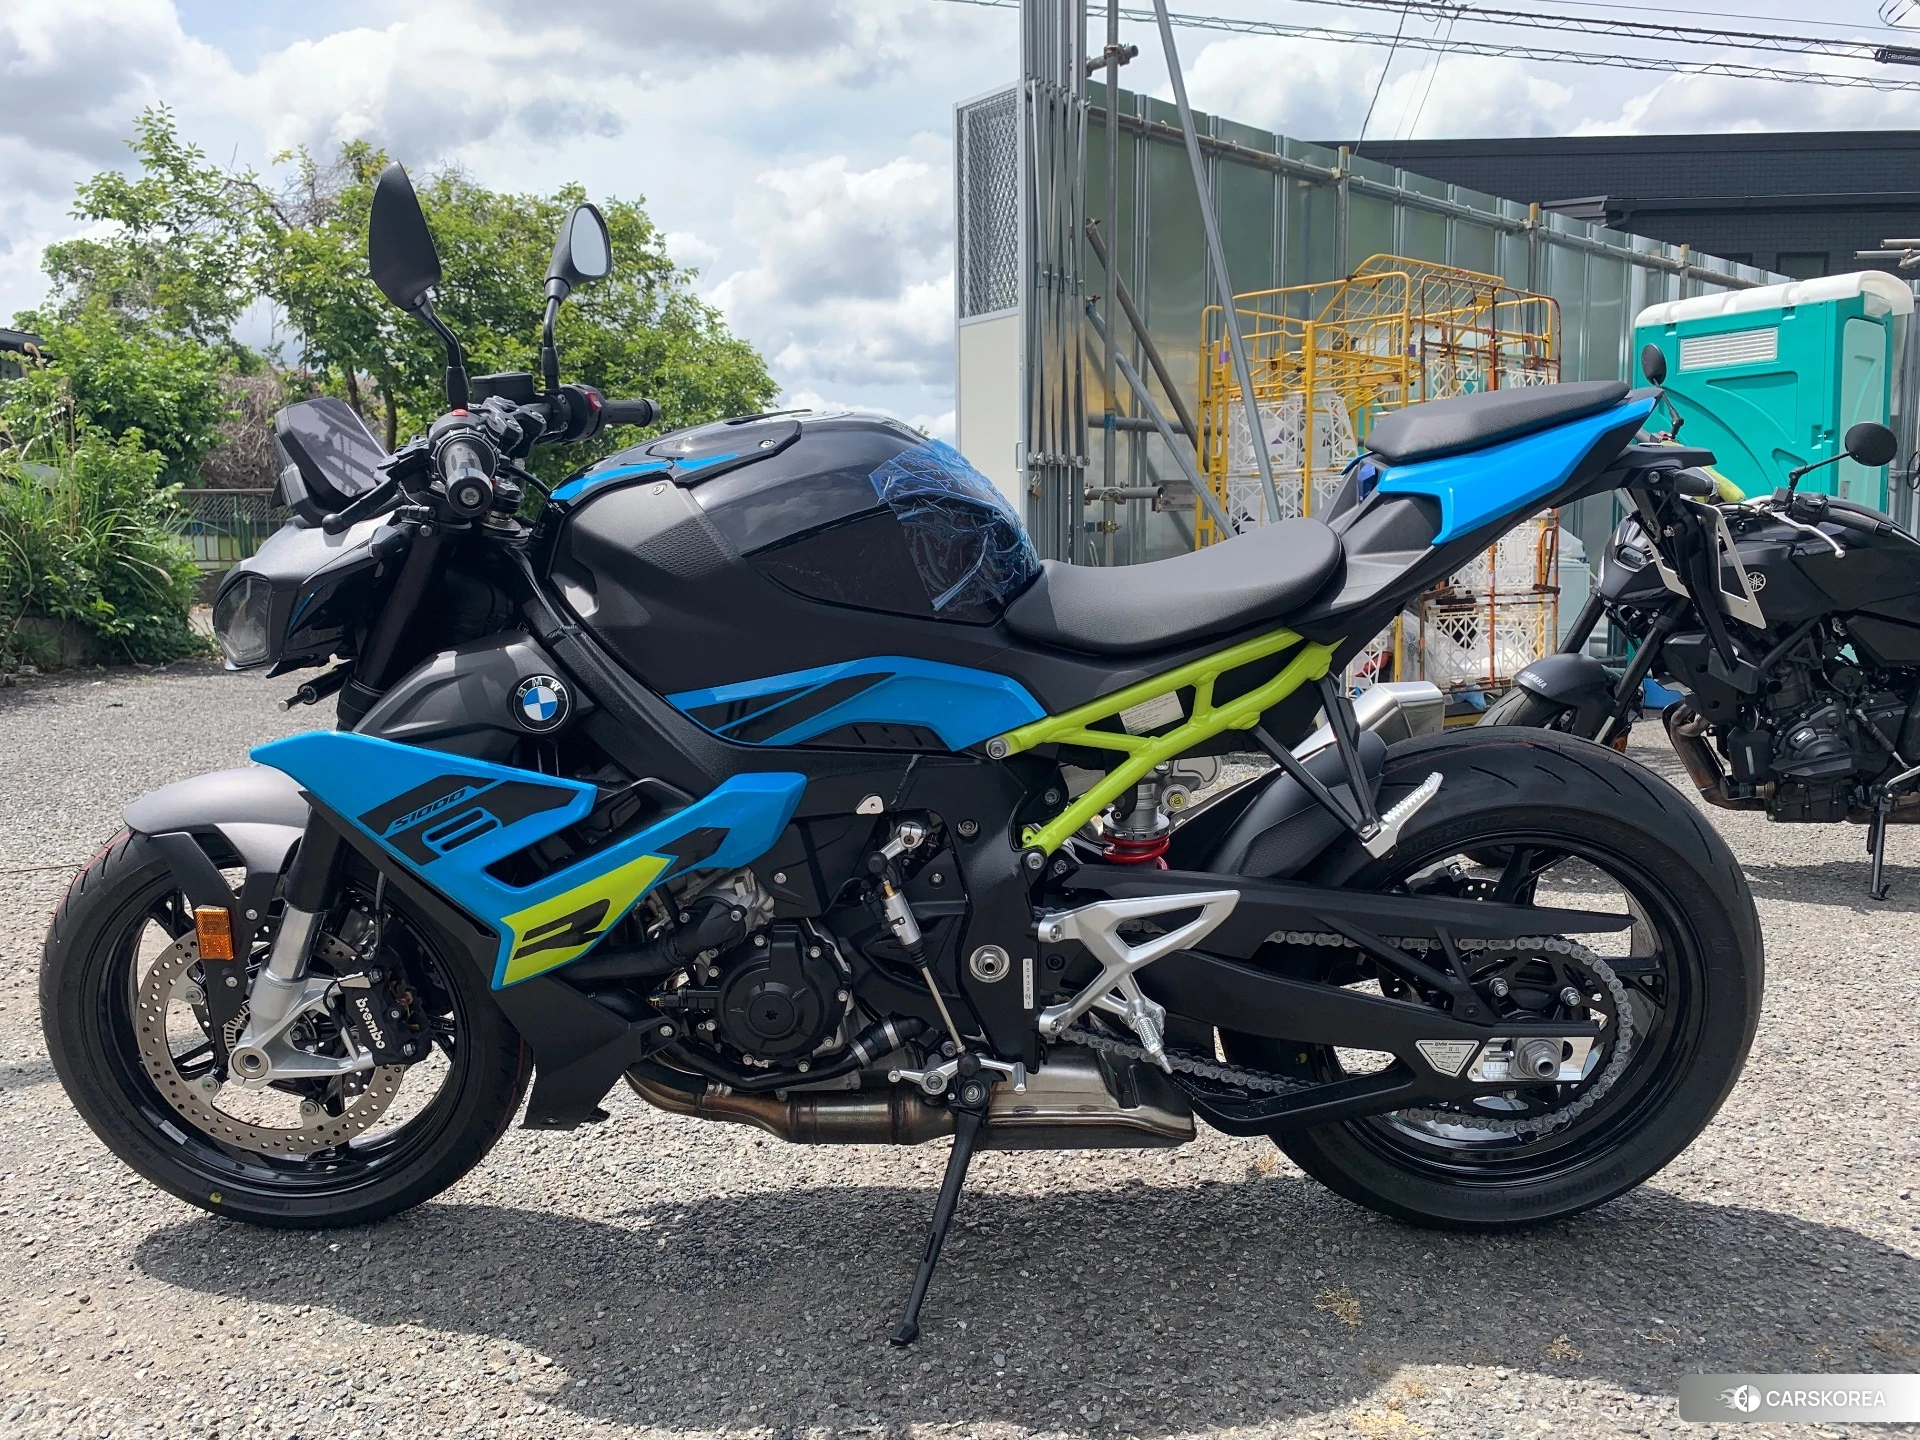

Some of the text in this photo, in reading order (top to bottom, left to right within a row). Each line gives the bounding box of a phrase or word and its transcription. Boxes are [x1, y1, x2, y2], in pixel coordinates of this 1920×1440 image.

[516, 677, 562, 698] BMW
[1520, 670, 1548, 690] YAMAHA
[393, 788, 467, 830] S1000
[355, 997, 386, 1049] brembo
